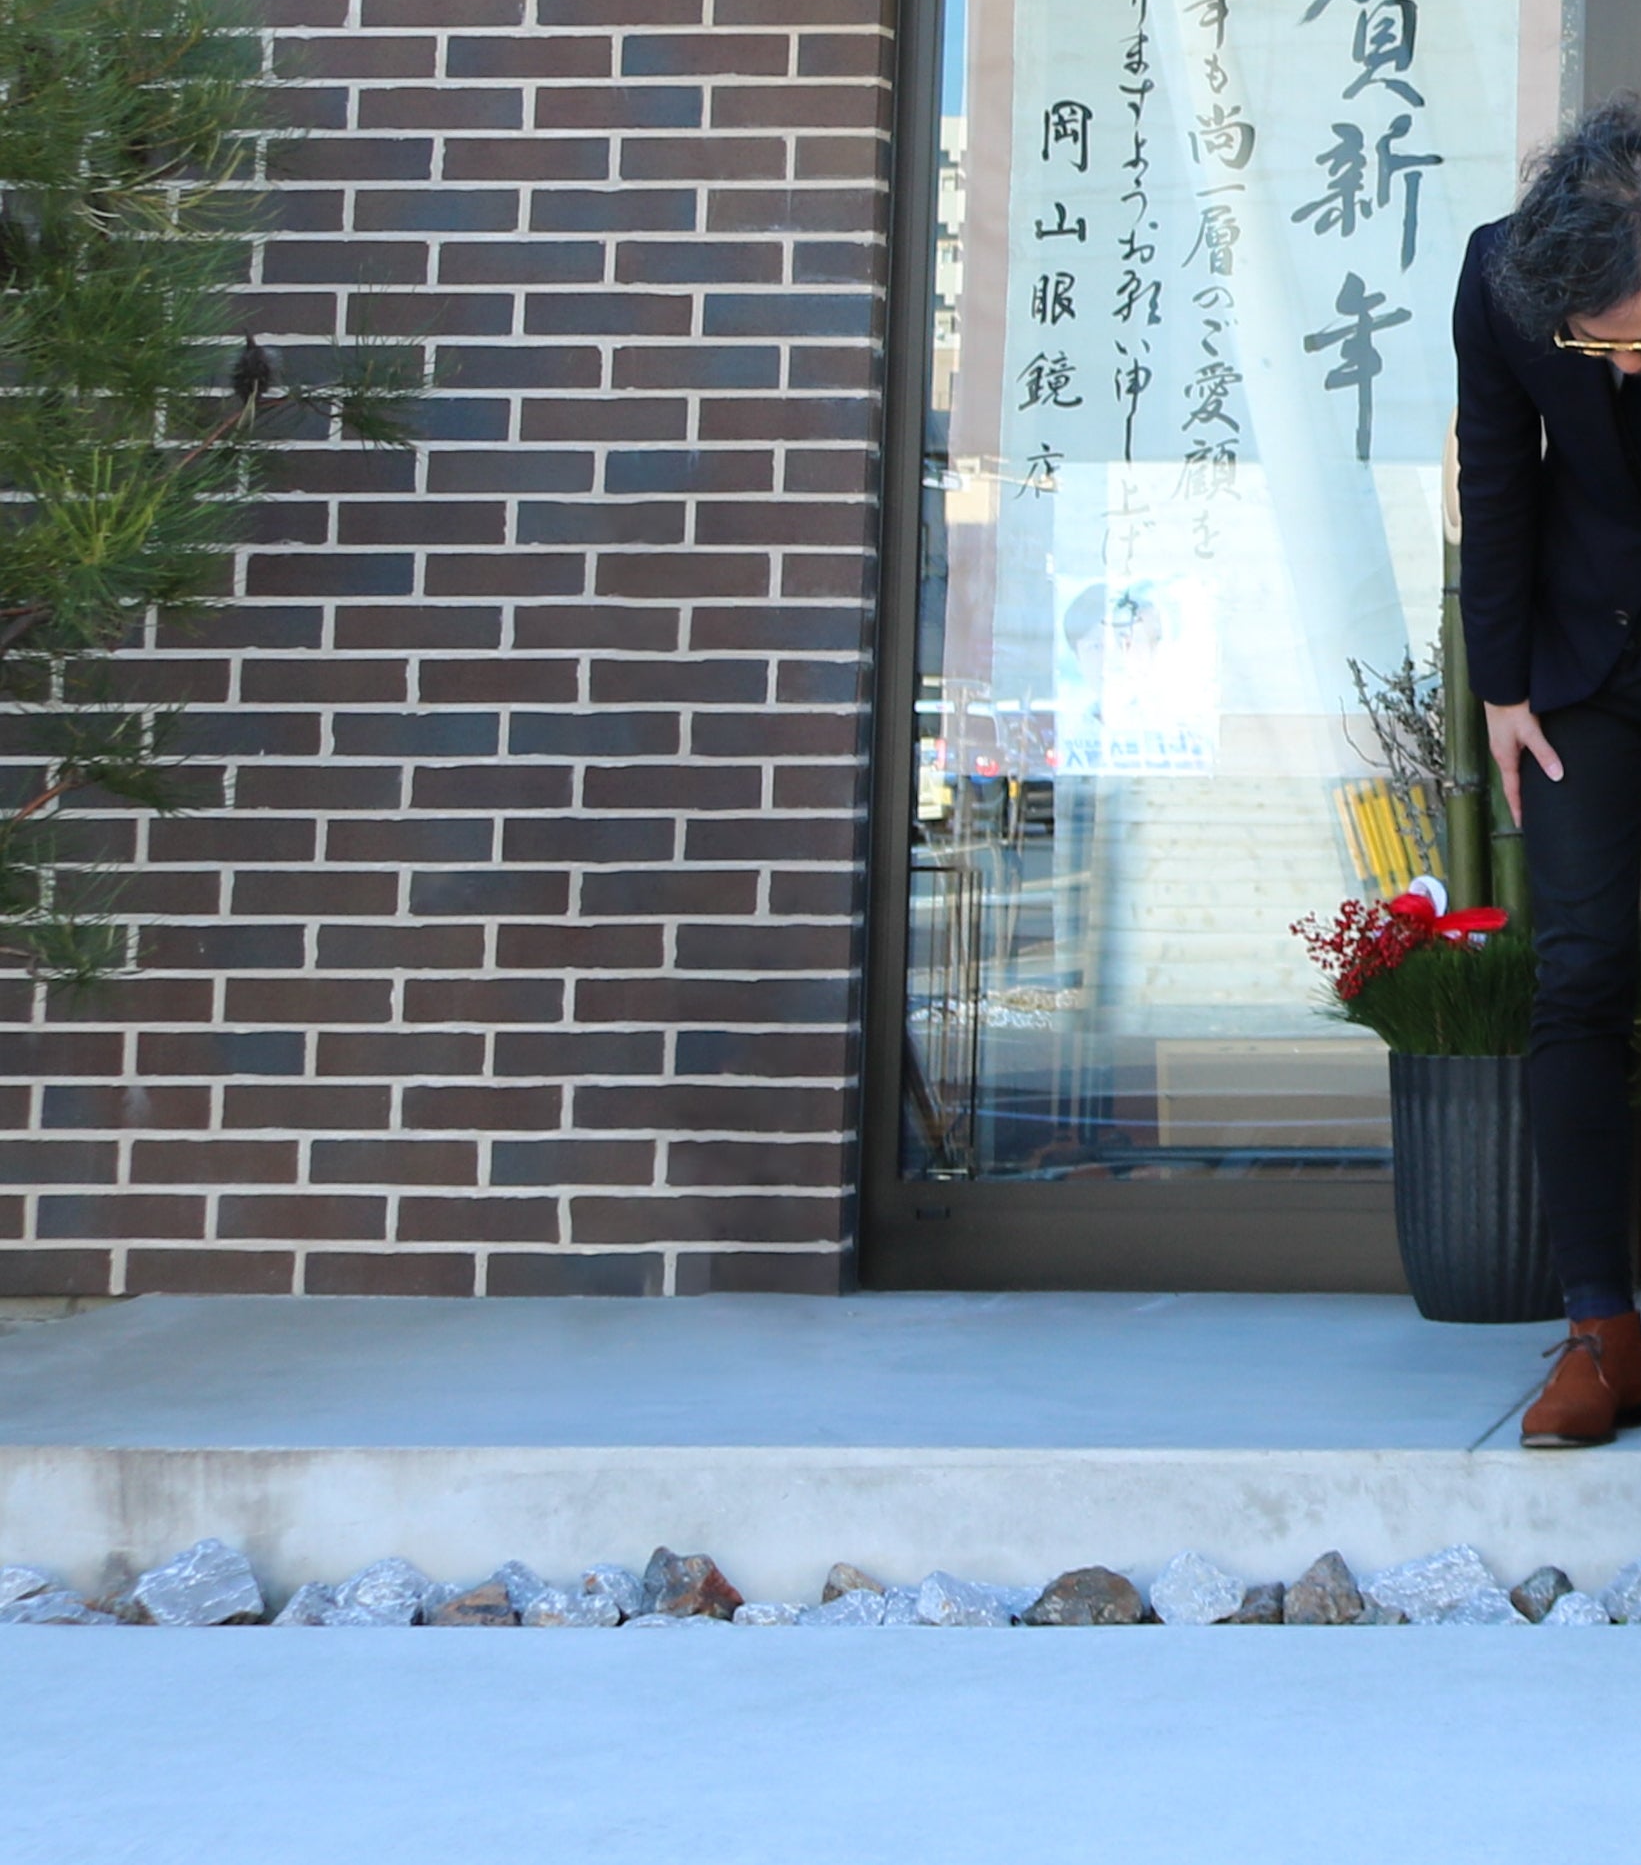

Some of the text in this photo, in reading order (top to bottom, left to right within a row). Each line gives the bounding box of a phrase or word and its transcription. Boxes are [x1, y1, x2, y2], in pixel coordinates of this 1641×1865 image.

[1015, 100, 1093, 501] 岡山眼鏡店
